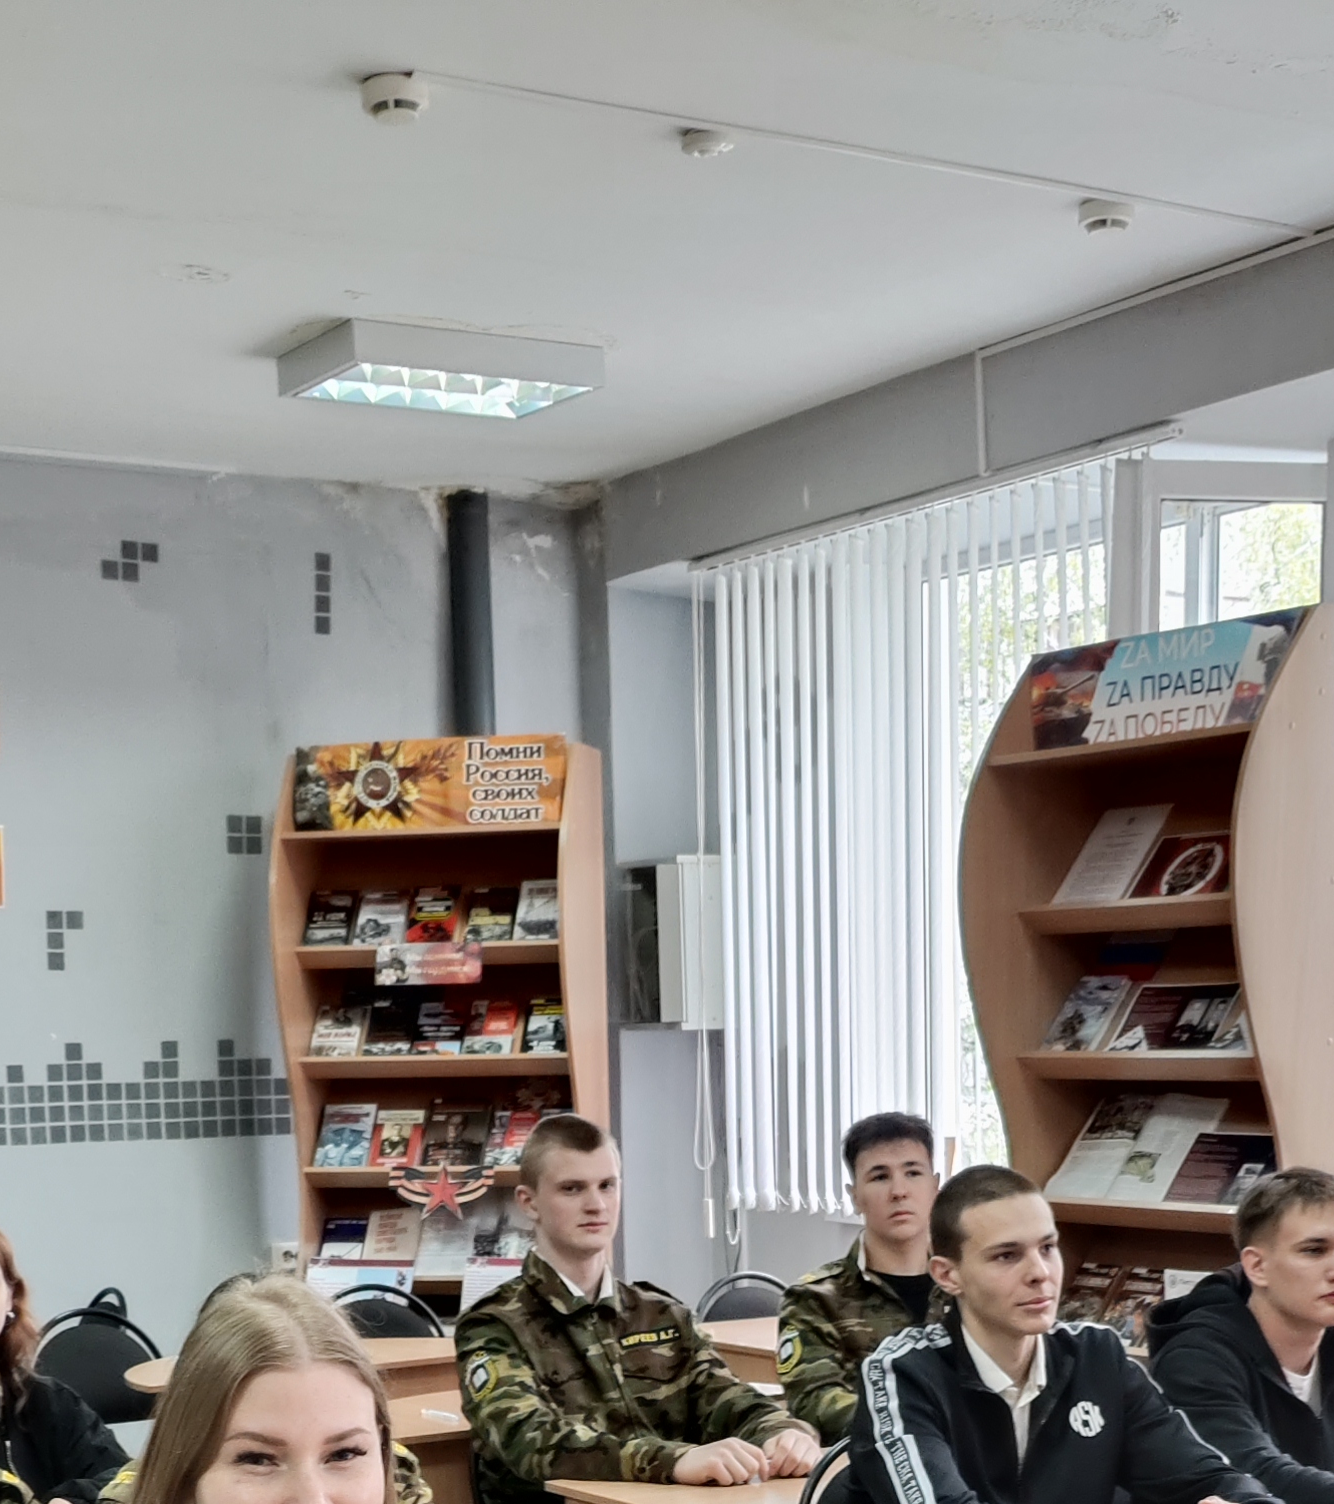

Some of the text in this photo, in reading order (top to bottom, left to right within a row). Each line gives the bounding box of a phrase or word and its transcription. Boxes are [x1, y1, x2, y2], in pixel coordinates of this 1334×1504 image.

[1121, 629, 1214, 668] ZA МИР
[1106, 662, 1240, 707] ZA ПРАВДУ
[1091, 702, 1226, 743] ZA ПОБЕДУ
[467, 741, 543, 760] Помни
[465, 763, 549, 784] Россия,
[472, 787, 537, 801] своих
[469, 805, 543, 822] солдат
